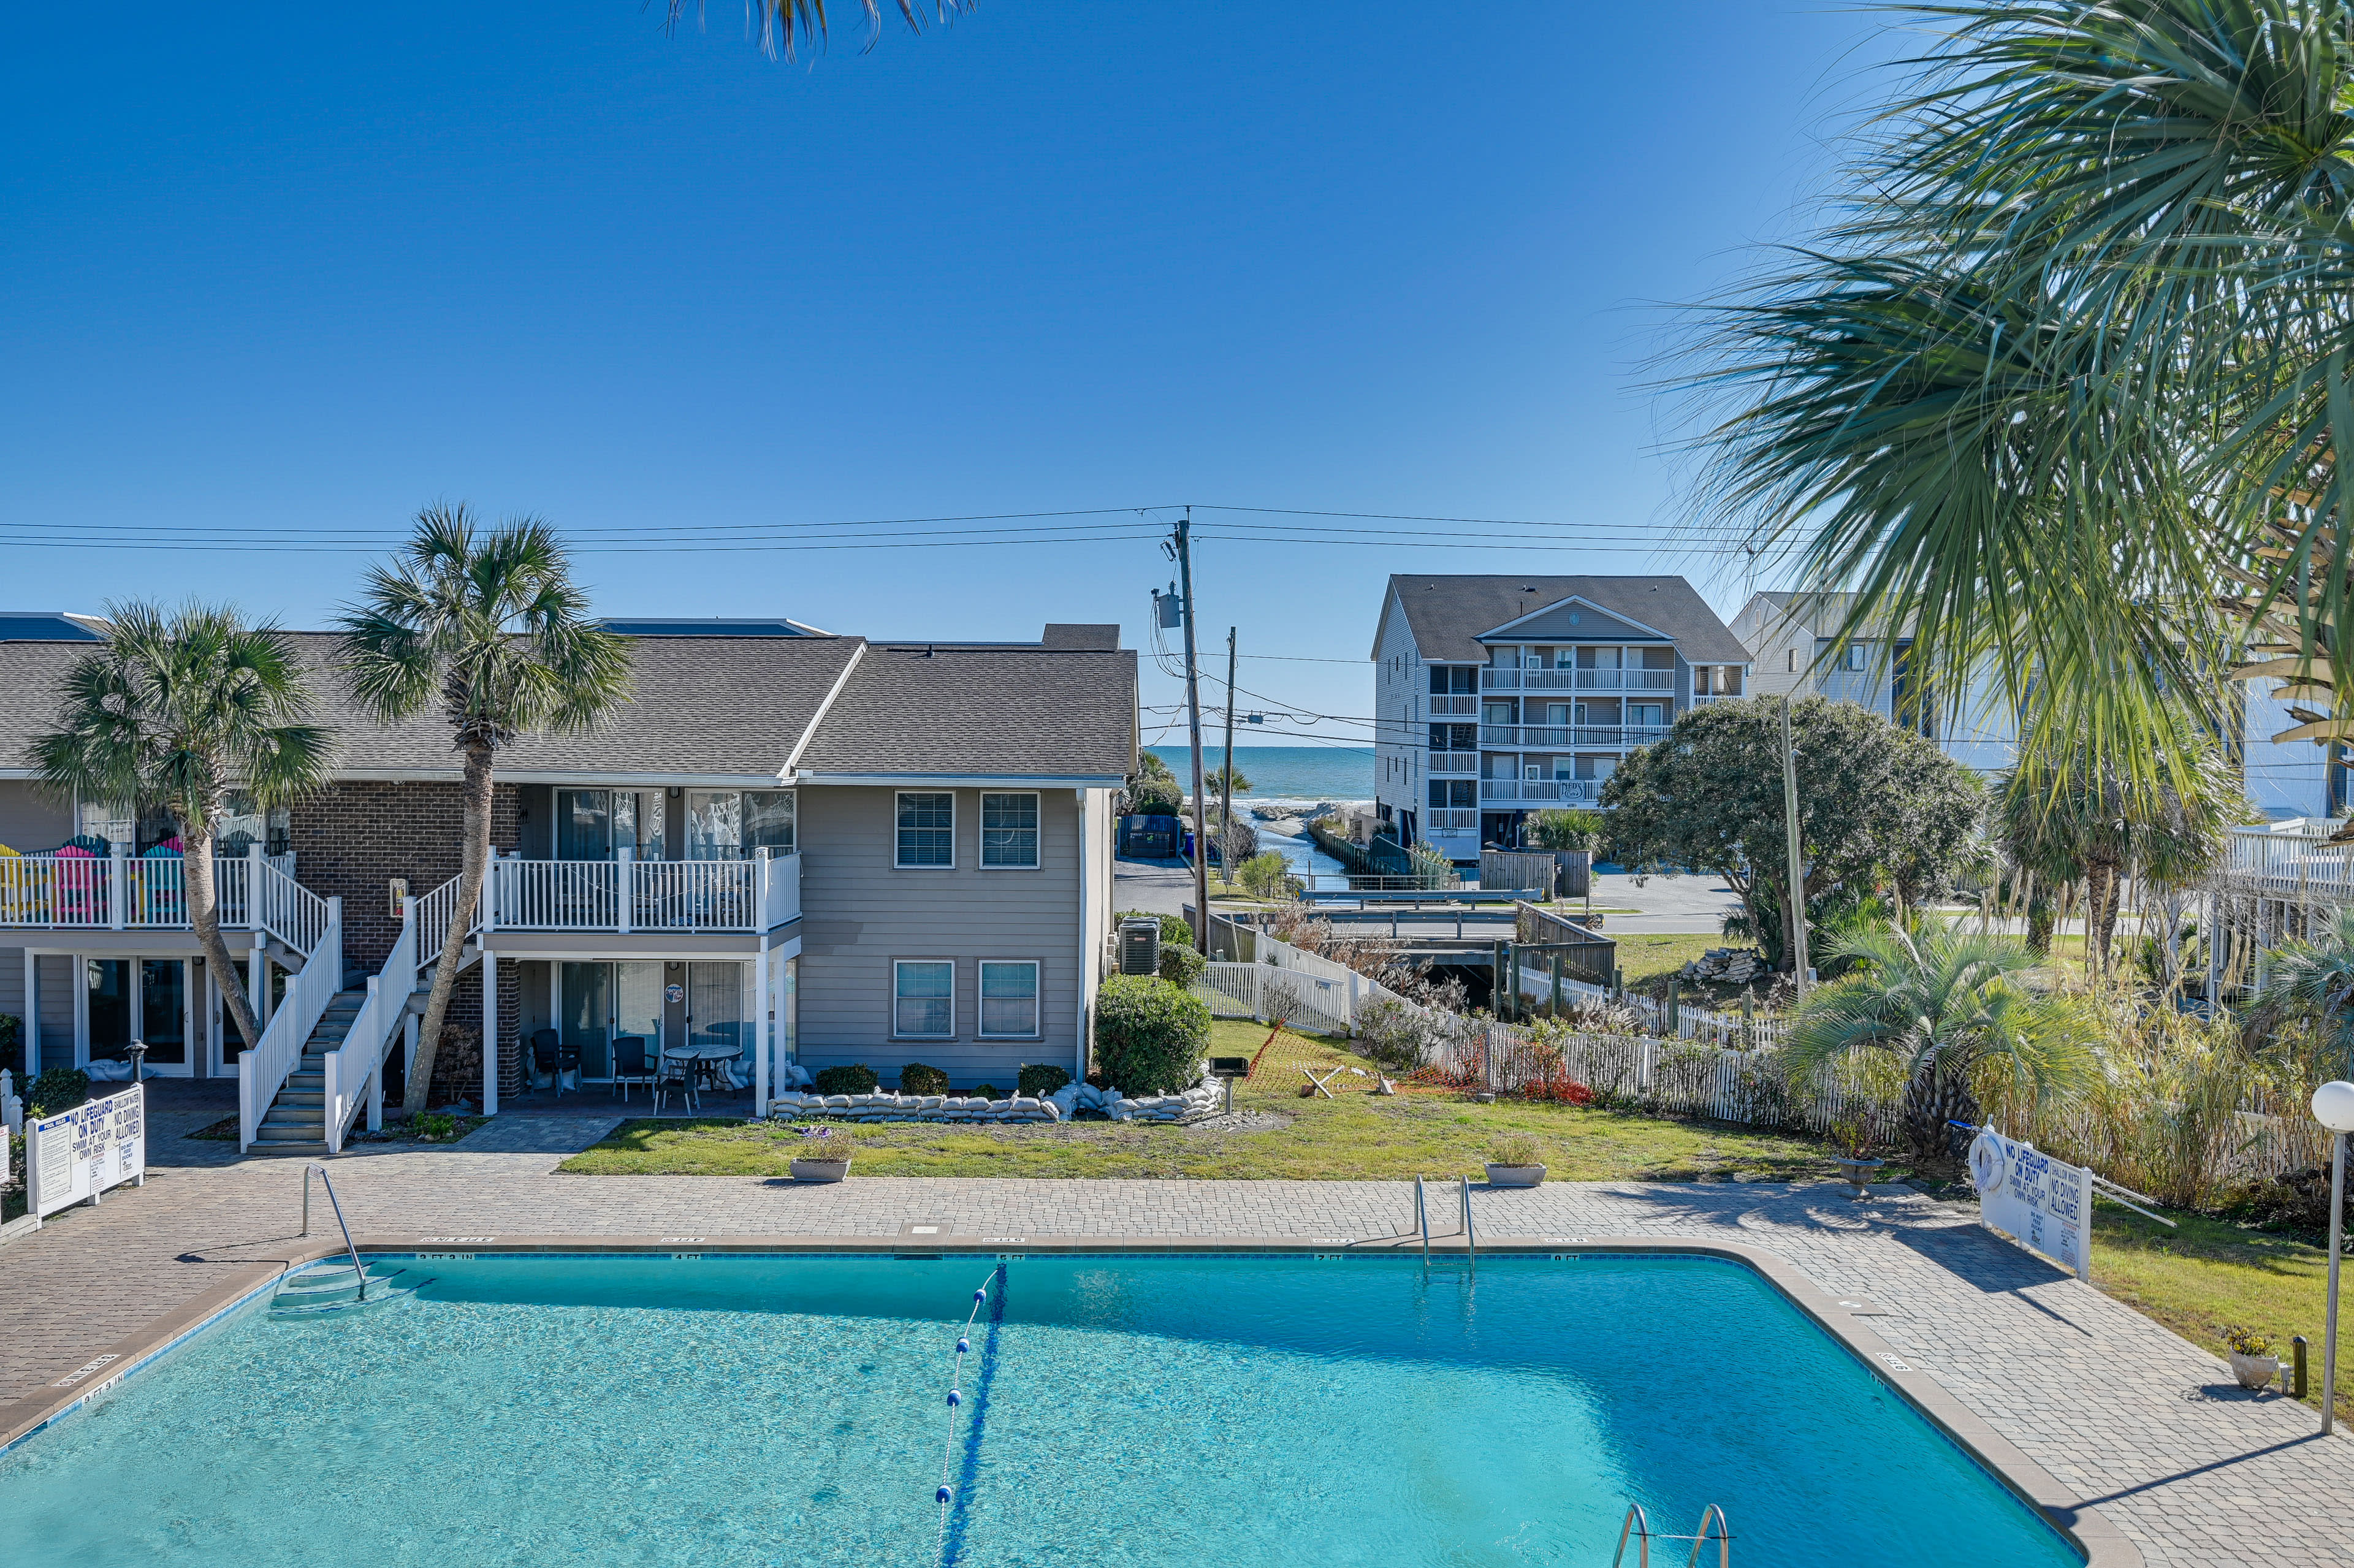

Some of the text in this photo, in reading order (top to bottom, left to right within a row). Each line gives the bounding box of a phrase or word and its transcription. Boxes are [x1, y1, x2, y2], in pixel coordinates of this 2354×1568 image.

[71, 1100, 113, 1126] NO LIFEGUARD
[114, 1094, 139, 1110] SHALLOW WATER
[55, 1117, 66, 1126] RULES
[115, 1105, 139, 1126] NO DIVING
[78, 1116, 104, 1139] ON DUTY
[115, 1120, 139, 1141] ALLOWED
[72, 1129, 111, 1152] SWIM AT YOUR
[79, 1141, 105, 1160] OWN RISK
[2006, 1143, 2049, 1174] NO LIFEGUARD
[2015, 1162, 2040, 1186] ON DUTY
[2052, 1165, 2079, 1187] SHALLOW WATER
[2009, 1174, 2045, 1201] SWIM AT YOUR
[2014, 1188, 2038, 1209] OWN RISK
[2051, 1178, 2079, 1203] NO DIVING
[2051, 1195, 2078, 1220] ALLOWED
[2031, 1224, 2042, 1233] DUCKS
[115, 1374, 123, 1385] IN
